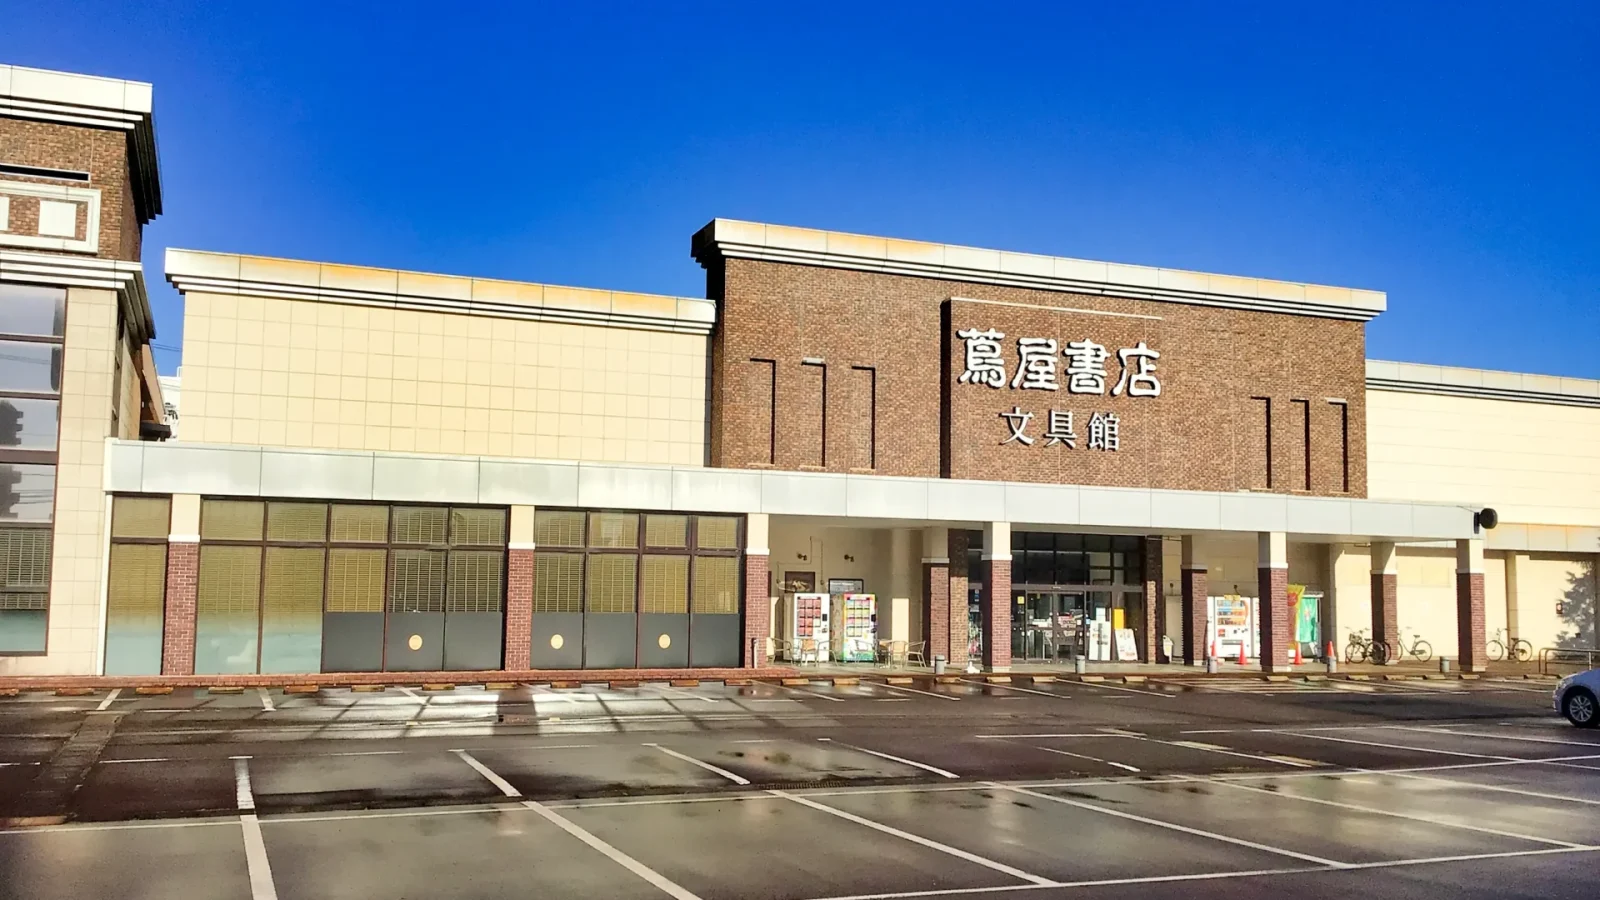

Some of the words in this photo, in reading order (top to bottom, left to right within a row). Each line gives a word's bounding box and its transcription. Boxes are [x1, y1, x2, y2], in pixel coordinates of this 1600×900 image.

[957, 327, 1162, 397] 蔦屋書店
[1000, 406, 1121, 451] 文具館
